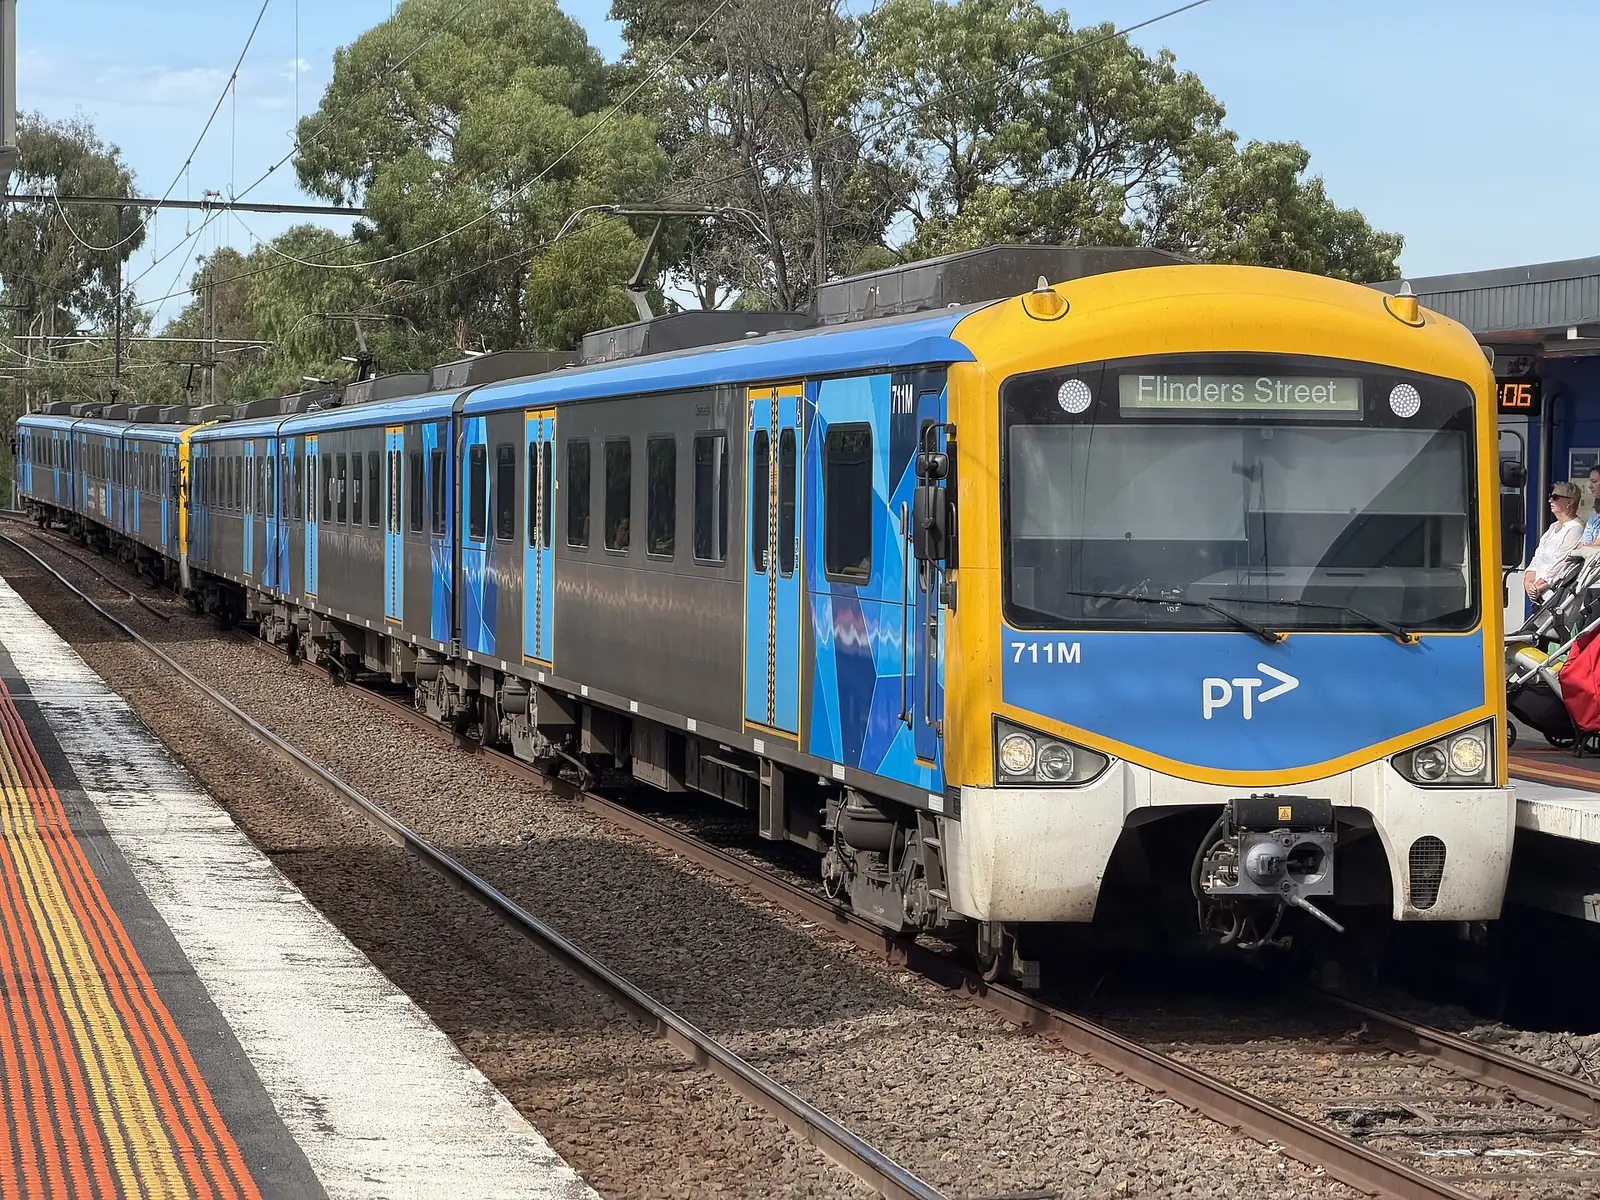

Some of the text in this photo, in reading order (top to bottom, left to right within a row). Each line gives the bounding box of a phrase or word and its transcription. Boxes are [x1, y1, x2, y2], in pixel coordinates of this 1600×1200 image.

[892, 383, 913, 414] 711M
[1138, 375, 1336, 404] Flinders Street
[1496, 383, 1531, 406] :06
[1011, 642, 1081, 664] 711M
